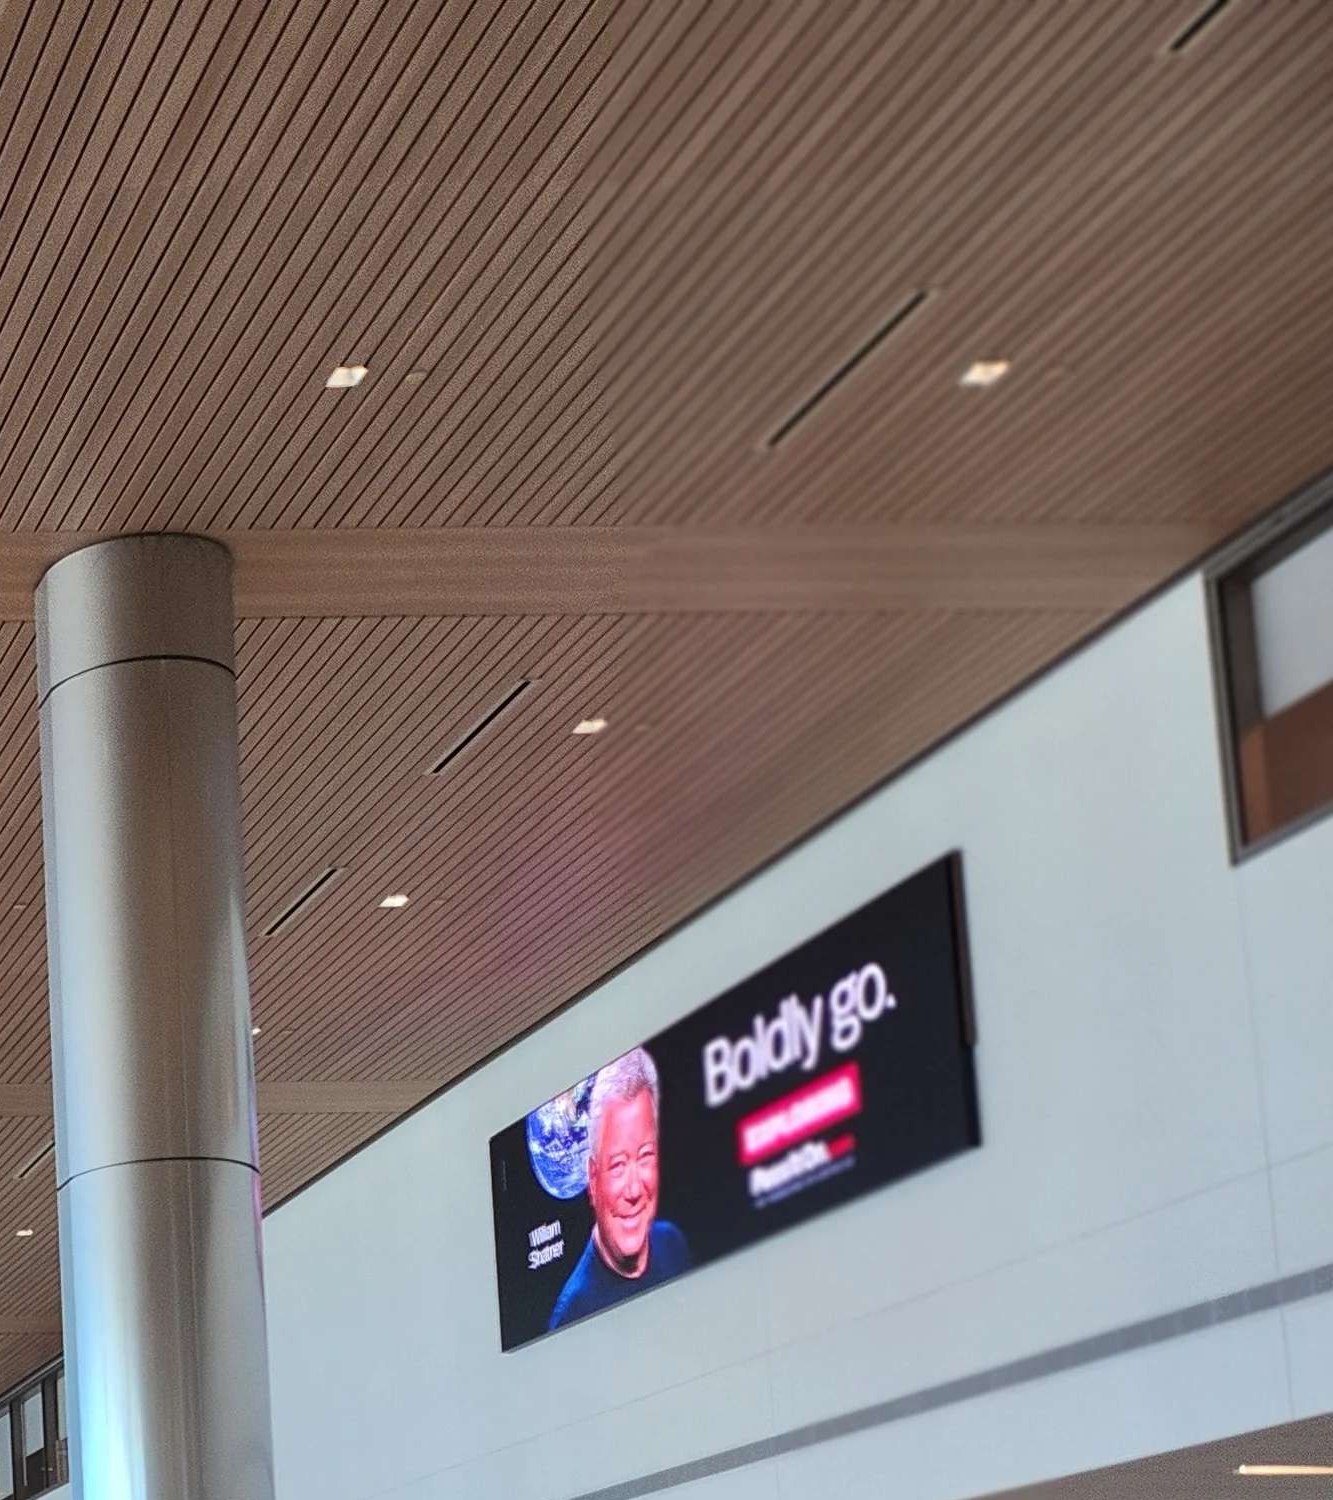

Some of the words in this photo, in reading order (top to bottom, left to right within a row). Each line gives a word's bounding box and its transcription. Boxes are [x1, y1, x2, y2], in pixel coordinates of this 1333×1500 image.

[702, 994, 823, 1107] Boldly
[829, 963, 896, 1052] go.
[528, 1220, 562, 1247] William
[528, 1239, 564, 1269] Shatner
